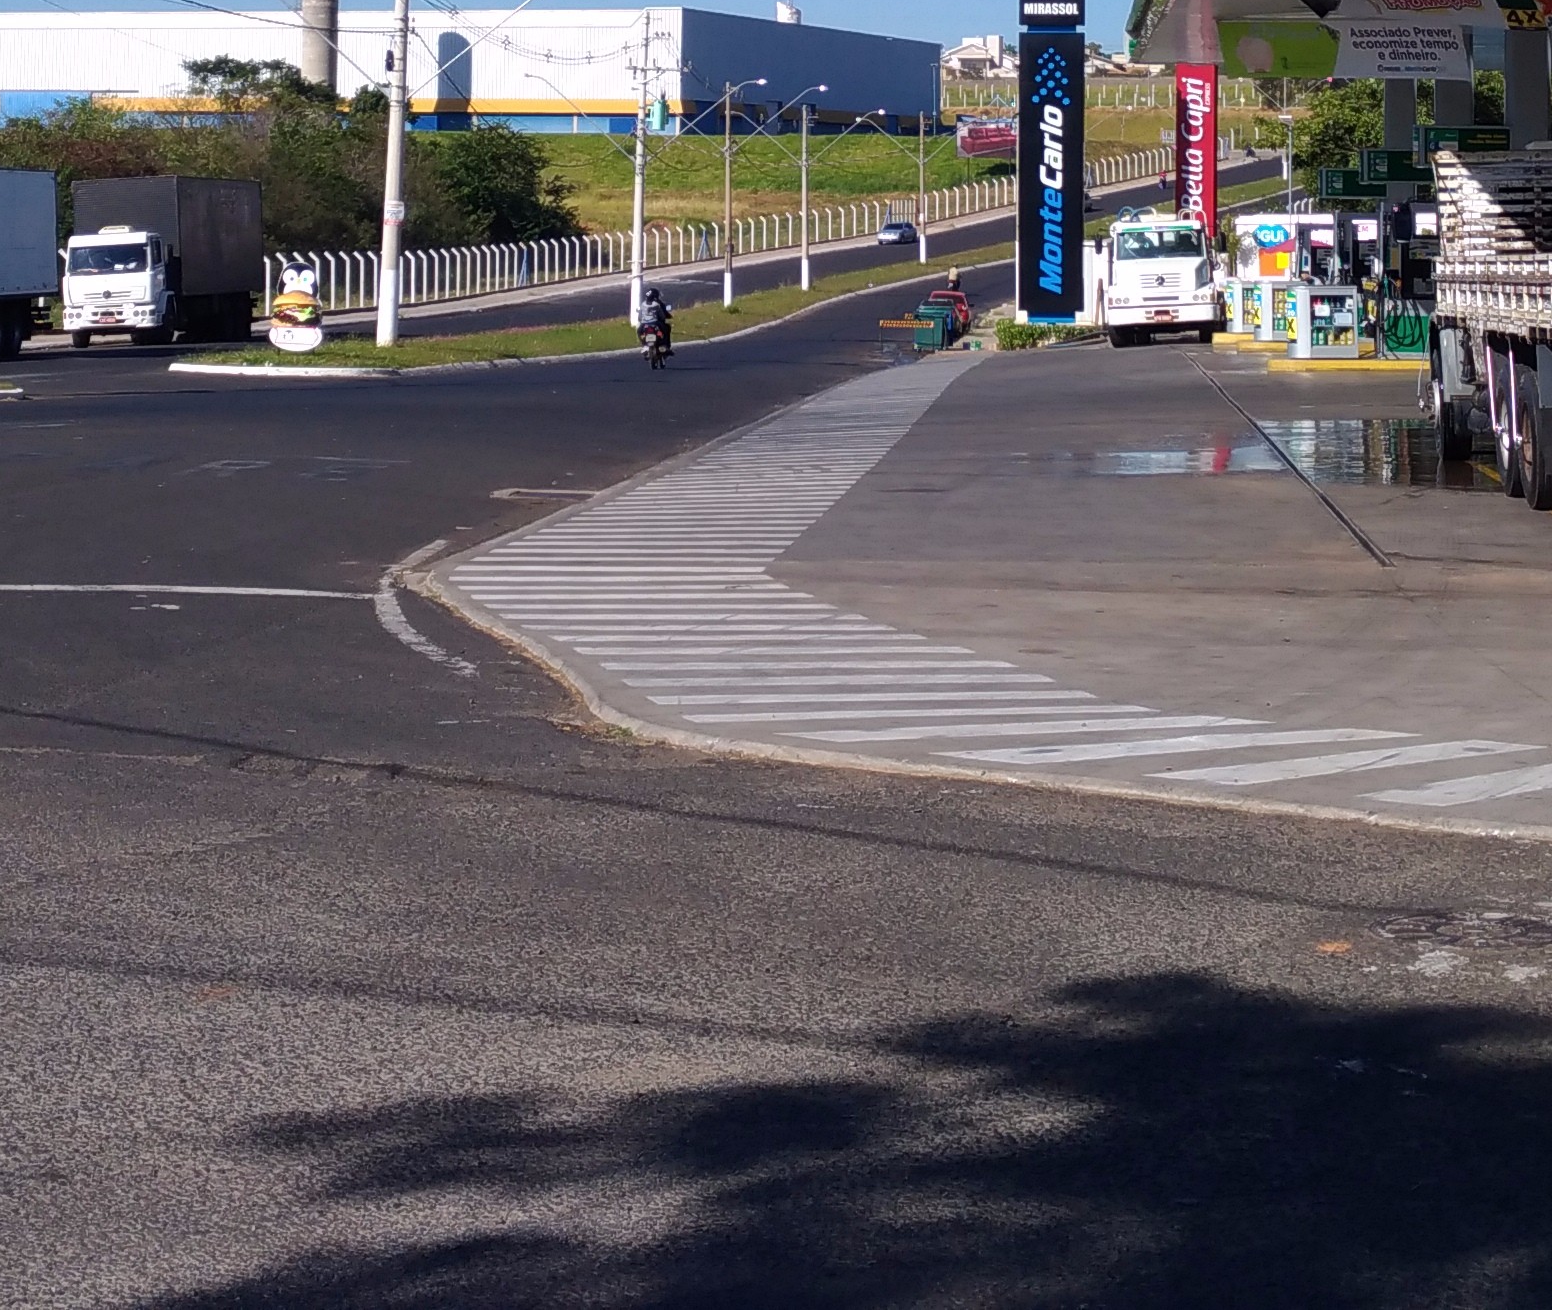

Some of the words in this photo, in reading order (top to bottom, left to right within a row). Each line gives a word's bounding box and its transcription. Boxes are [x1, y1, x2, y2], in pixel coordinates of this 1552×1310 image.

[1023, 2, 1080, 15] MIRASSOL
[1350, 26, 1411, 38] Associado
[1413, 27, 1457, 40] Prever,
[1352, 38, 1418, 49] economize
[1421, 38, 1459, 51] tempo
[1378, 51, 1386, 61] e
[1388, 49, 1442, 61] dinheiro.
[1181, 77, 1211, 142] Capri
[1181, 148, 1203, 211] Bella
[1039, 104, 1063, 295] MonteCarlo
